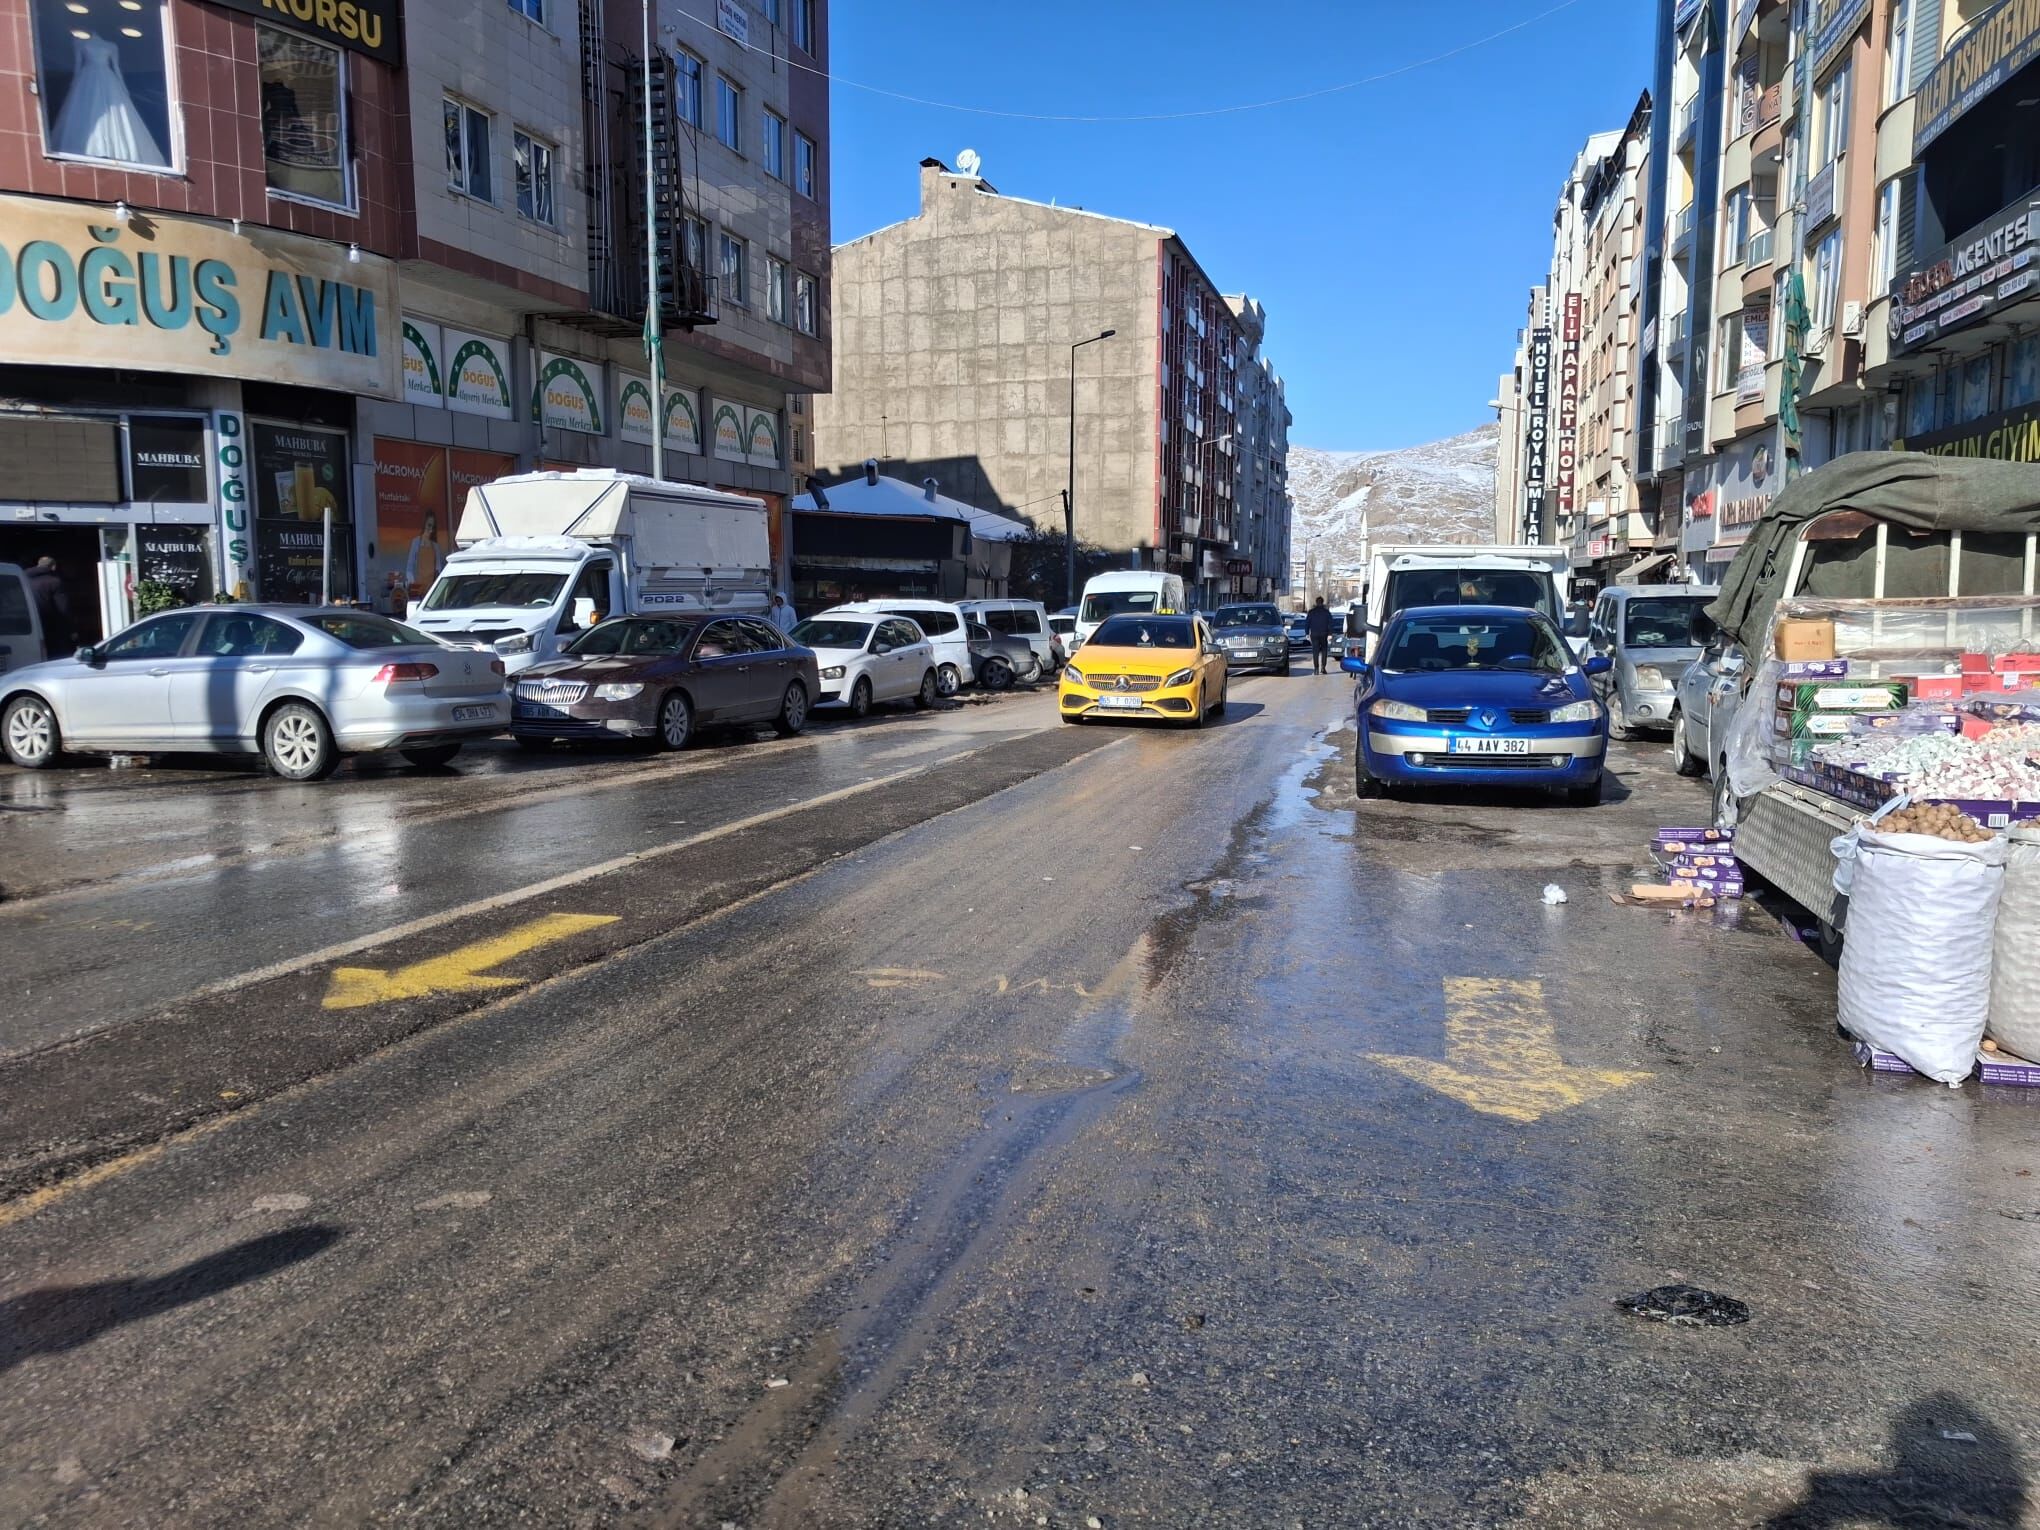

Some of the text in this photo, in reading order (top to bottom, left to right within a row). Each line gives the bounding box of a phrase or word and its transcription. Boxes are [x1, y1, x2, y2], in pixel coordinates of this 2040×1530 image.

[1914, 58, 1950, 137] KALEM
[0, 225, 377, 357] OĞUŞ AVM
[1744, 312, 1770, 324] EMLA
[1534, 342, 1547, 406] HOTEL
[1561, 353, 1578, 427] APART
[1530, 416, 1544, 479] ROYAL
[1558, 439, 1574, 515] HOTEL
[219, 415, 249, 568] DOĞUŞ
[279, 532, 324, 546] MAHBUB
[643, 595, 685, 604] 2022
[1477, 739, 1499, 752] AAV
[1503, 740, 1525, 753] 382
